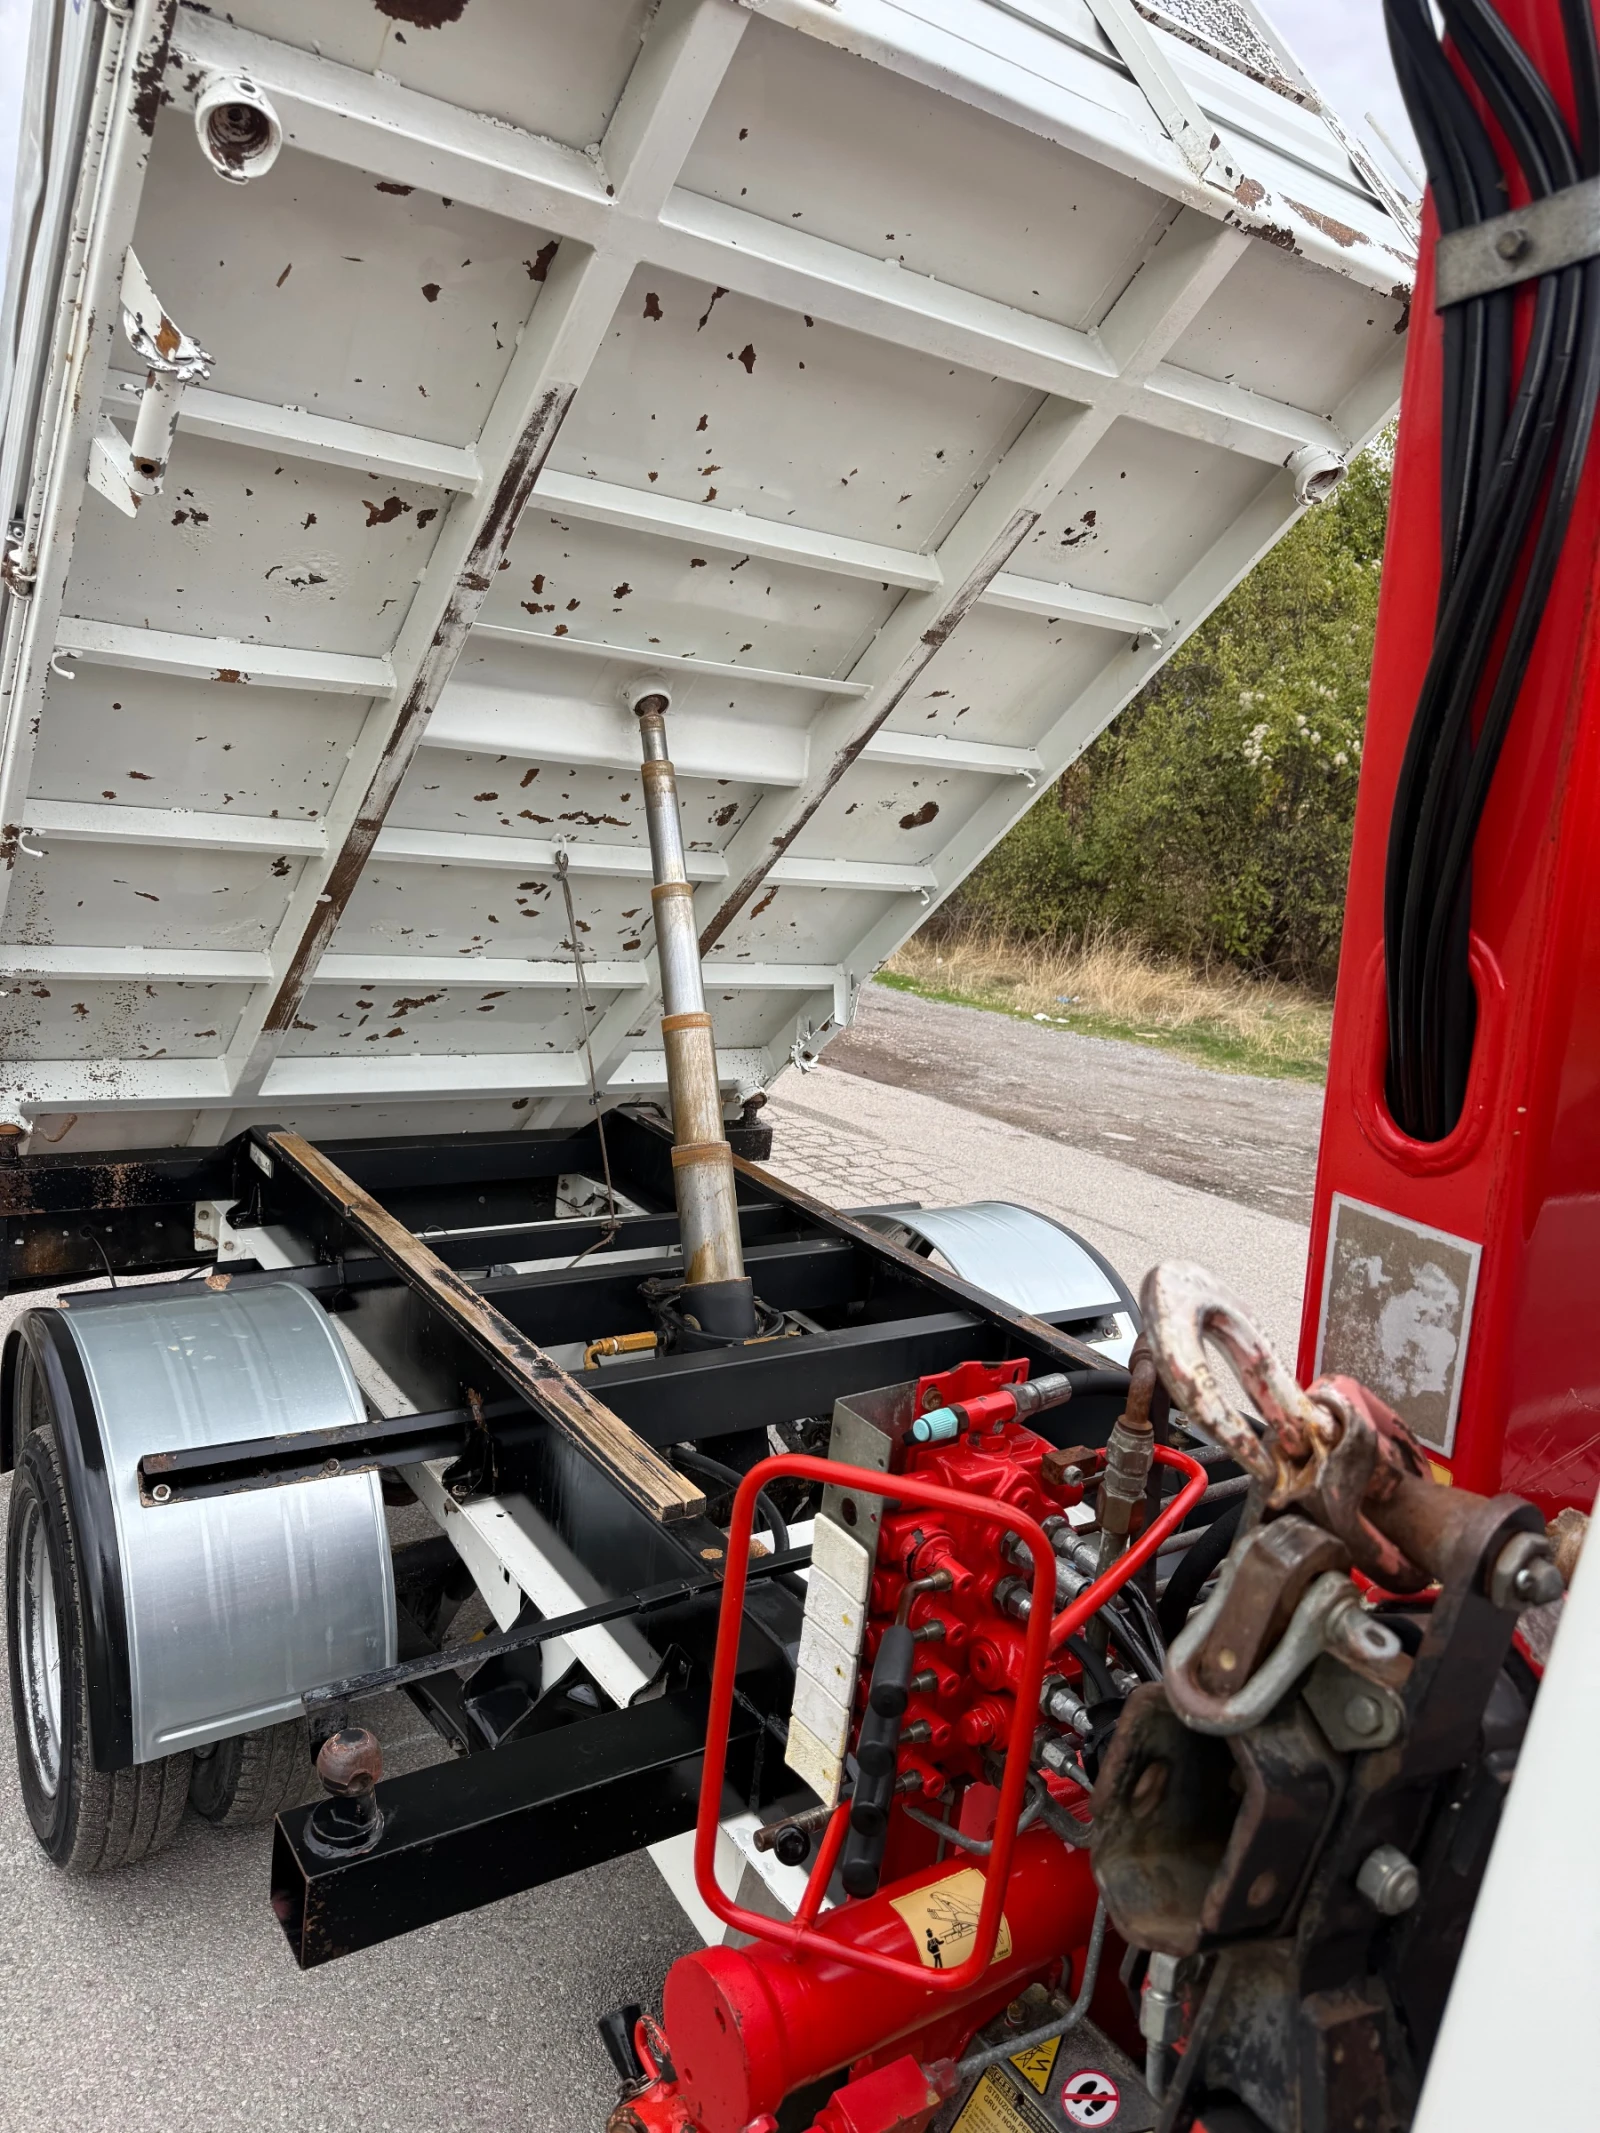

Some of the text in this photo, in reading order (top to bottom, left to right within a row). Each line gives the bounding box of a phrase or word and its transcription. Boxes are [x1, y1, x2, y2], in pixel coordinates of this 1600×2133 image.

[983, 2094, 998, 2111] GRU
[996, 2109, 1003, 2118] E
[985, 2084, 1019, 2123] ISTRUZIONI
